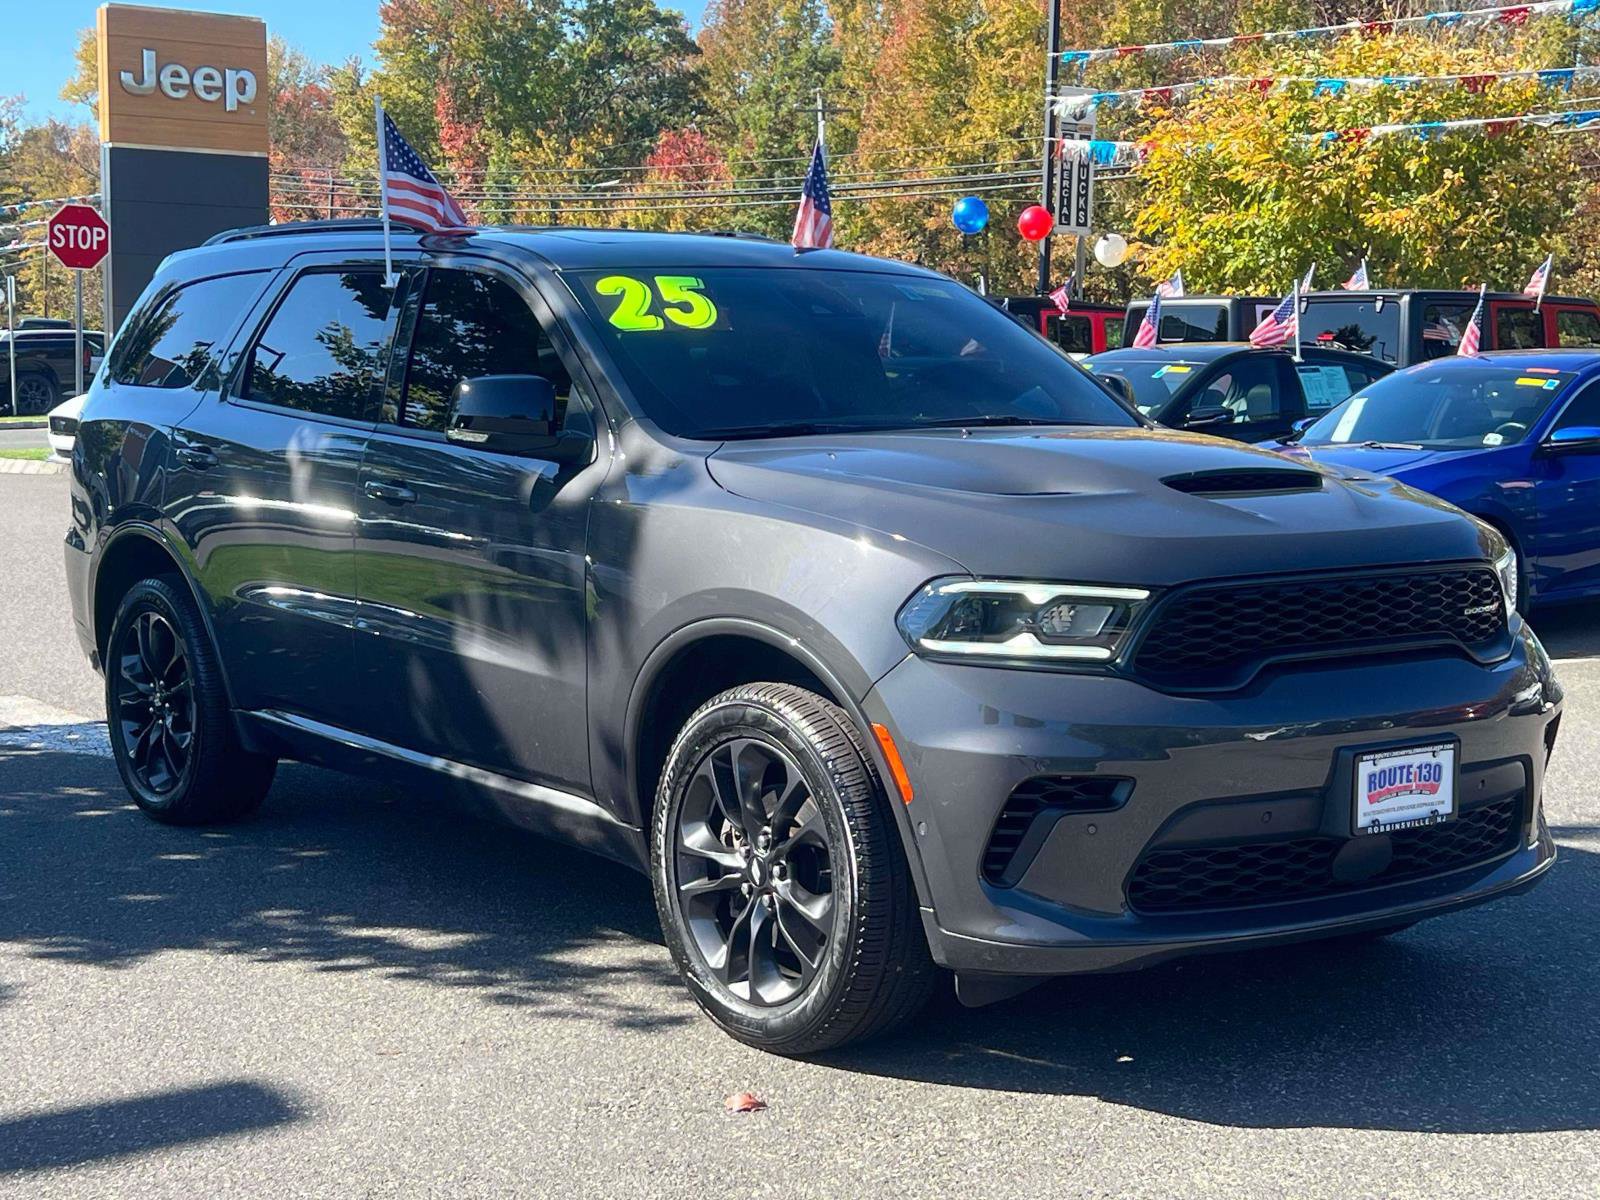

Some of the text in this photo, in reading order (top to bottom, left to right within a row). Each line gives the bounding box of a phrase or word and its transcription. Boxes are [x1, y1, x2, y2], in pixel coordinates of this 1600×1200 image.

[120, 48, 257, 112] Jeep
[51, 223, 106, 250] STOP
[595, 275, 718, 332] 25
[1368, 763, 1442, 792] ROUTE 130
[1436, 816, 1447, 824] NJ
